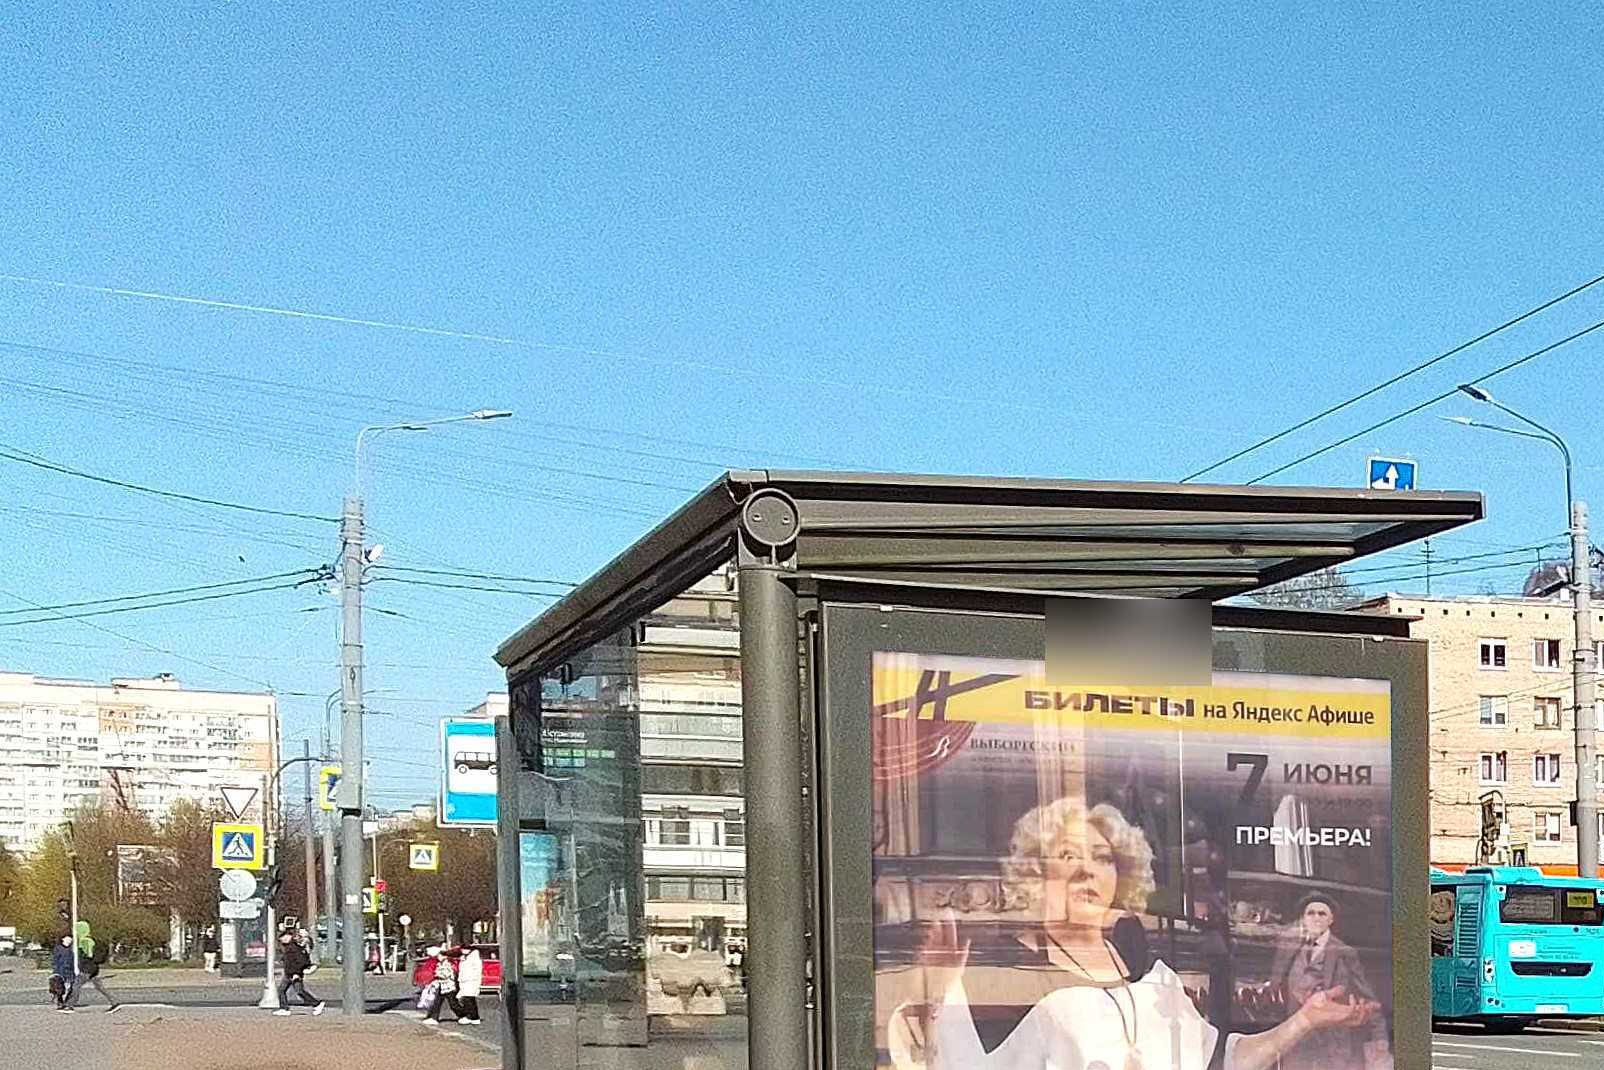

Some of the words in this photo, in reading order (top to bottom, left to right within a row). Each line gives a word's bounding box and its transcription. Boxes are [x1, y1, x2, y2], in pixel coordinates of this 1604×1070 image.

[1024, 689, 1194, 717] БИЛЕТЫ
[1203, 703, 1227, 719] на
[1232, 701, 1303, 723] Яндекс
[1307, 704, 1376, 726] Афише
[1226, 753, 1269, 804] 7
[1283, 762, 1372, 785] ИЮНЯ
[1236, 826, 1372, 847] ПРЕМЬЕРА!
